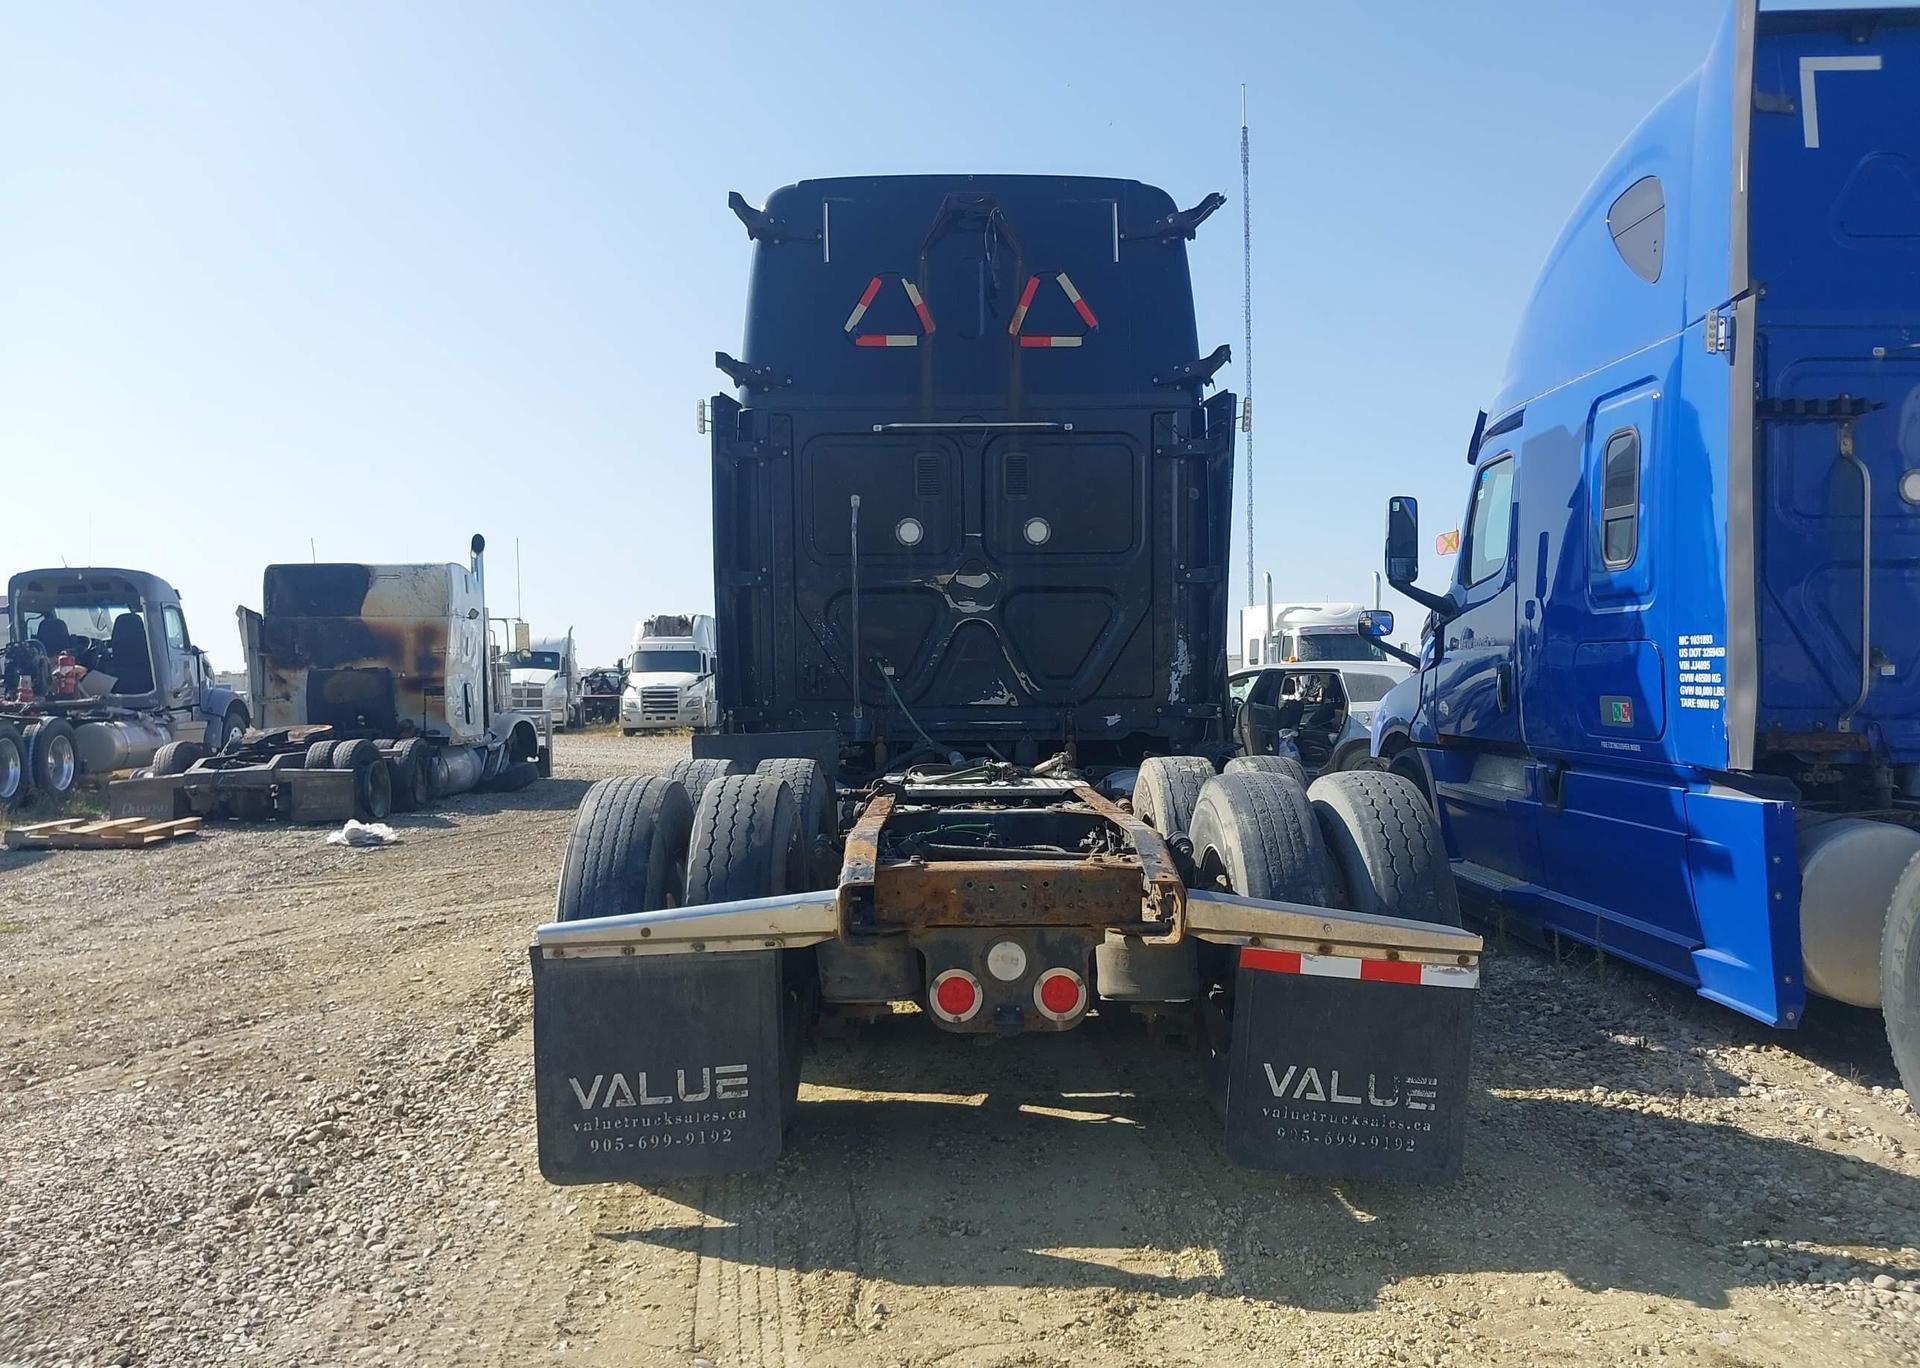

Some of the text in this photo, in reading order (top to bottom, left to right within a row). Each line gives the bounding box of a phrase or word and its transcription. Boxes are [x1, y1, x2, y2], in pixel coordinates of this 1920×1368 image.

[1679, 648, 1688, 657] US
[1689, 648, 1702, 657] DOT
[1713, 686, 1725, 696] LBS
[569, 1064, 749, 1110] VALUE
[1263, 1063, 1438, 1111] VALUE
[572, 1109, 747, 1133] valuetrucksales.ca
[1262, 1107, 1432, 1132] valuetrucksales.ca
[591, 1129, 732, 1152] 905-699-9192
